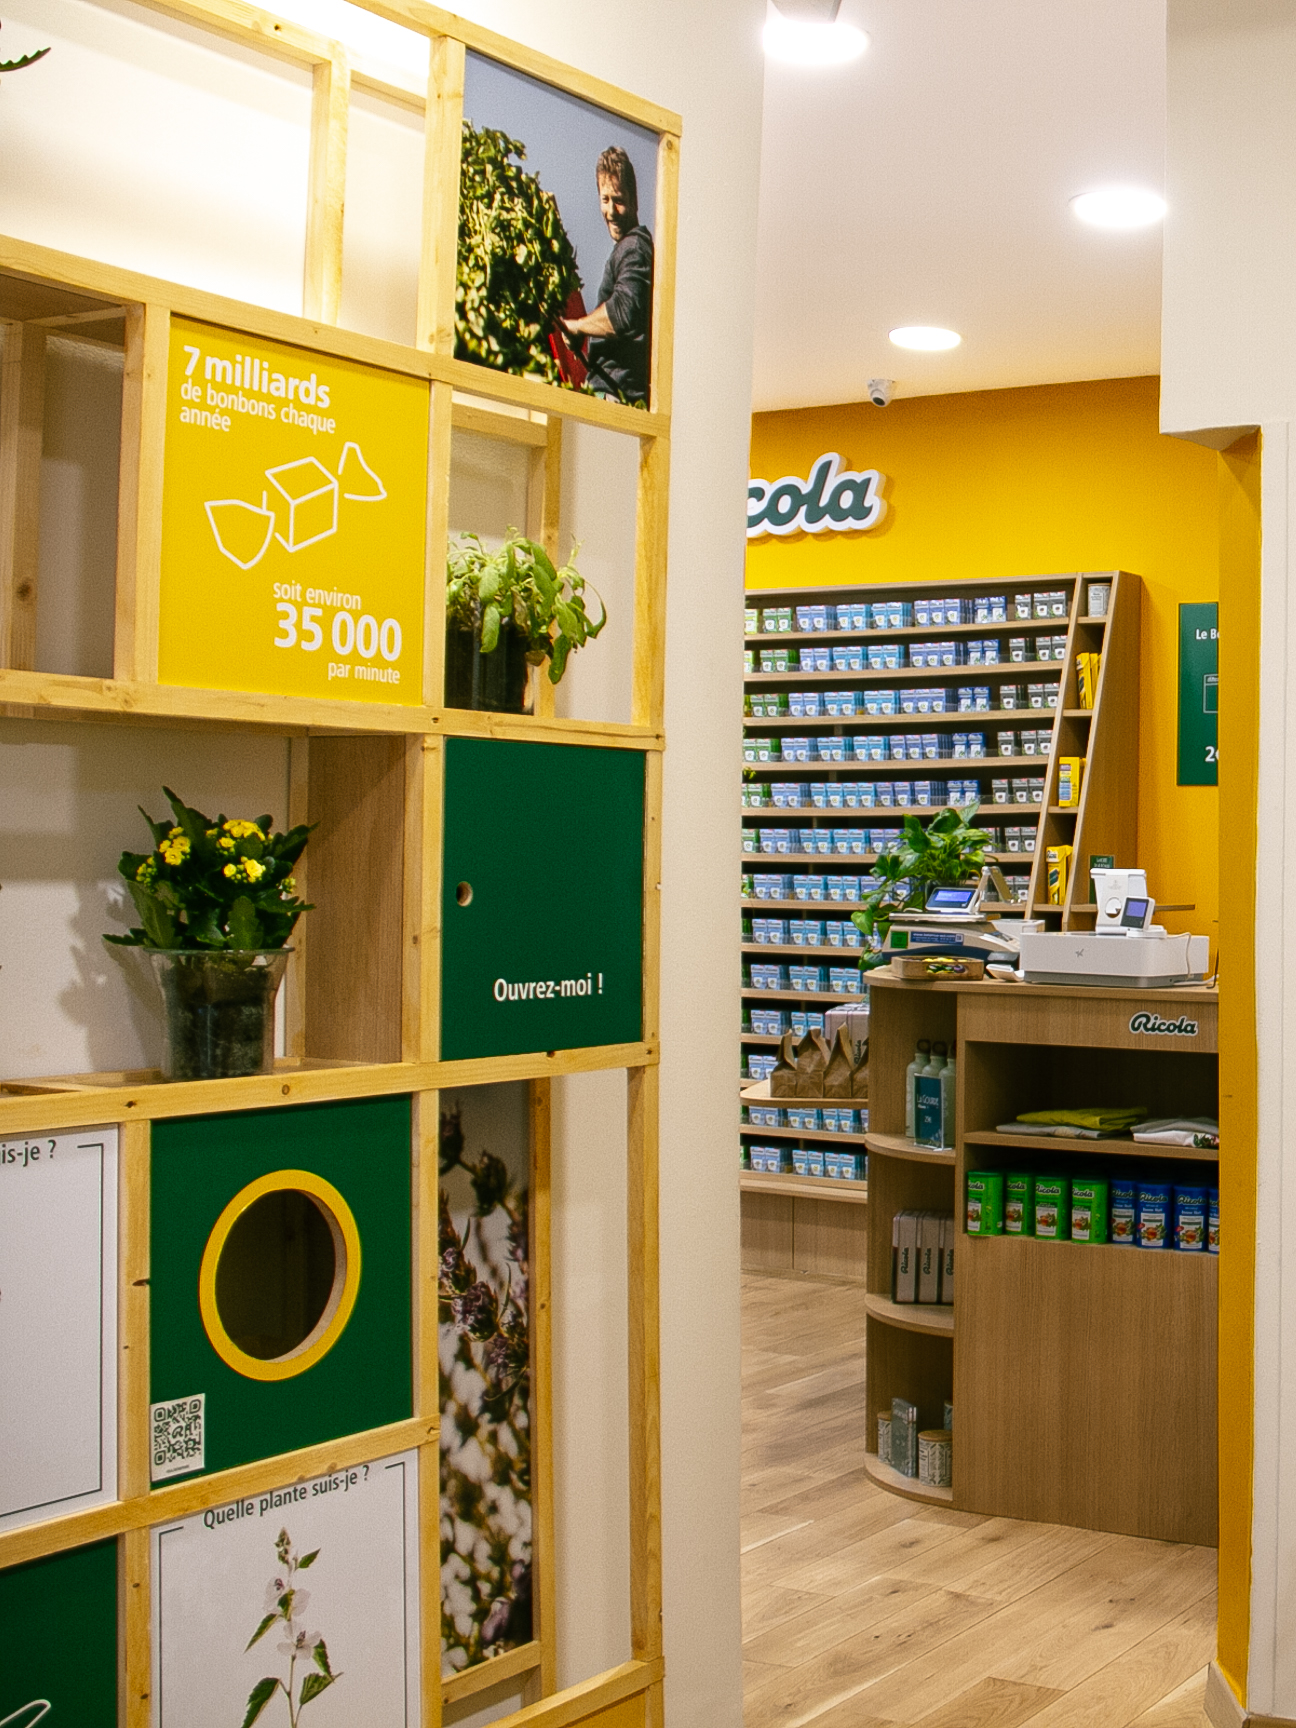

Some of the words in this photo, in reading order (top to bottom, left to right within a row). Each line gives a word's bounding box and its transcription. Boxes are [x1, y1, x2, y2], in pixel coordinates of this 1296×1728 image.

[184, 345, 201, 376] 7
[204, 354, 331, 409] milliards
[179, 406, 232, 432] année
[180, 378, 202, 402] de
[206, 383, 277, 420] bonbons
[280, 403, 337, 435] chaque
[273, 580, 302, 602] soit
[305, 586, 362, 611] environ
[273, 601, 324, 652] 35
[331, 610, 403, 662] 000
[1195, 628, 1208, 640] Le
[327, 661, 351, 681] par
[354, 662, 401, 685] minute
[493, 972, 593, 1002] Ouvrez-moi
[597, 972, 604, 995] !
[1130, 1013, 1197, 1035] Ricola
[47, 1139, 57, 1159] ?
[203, 1499, 254, 1530] Quelle
[259, 1485, 307, 1516] plante
[311, 1468, 358, 1497] suis-je
[362, 1464, 370, 1482] ?
